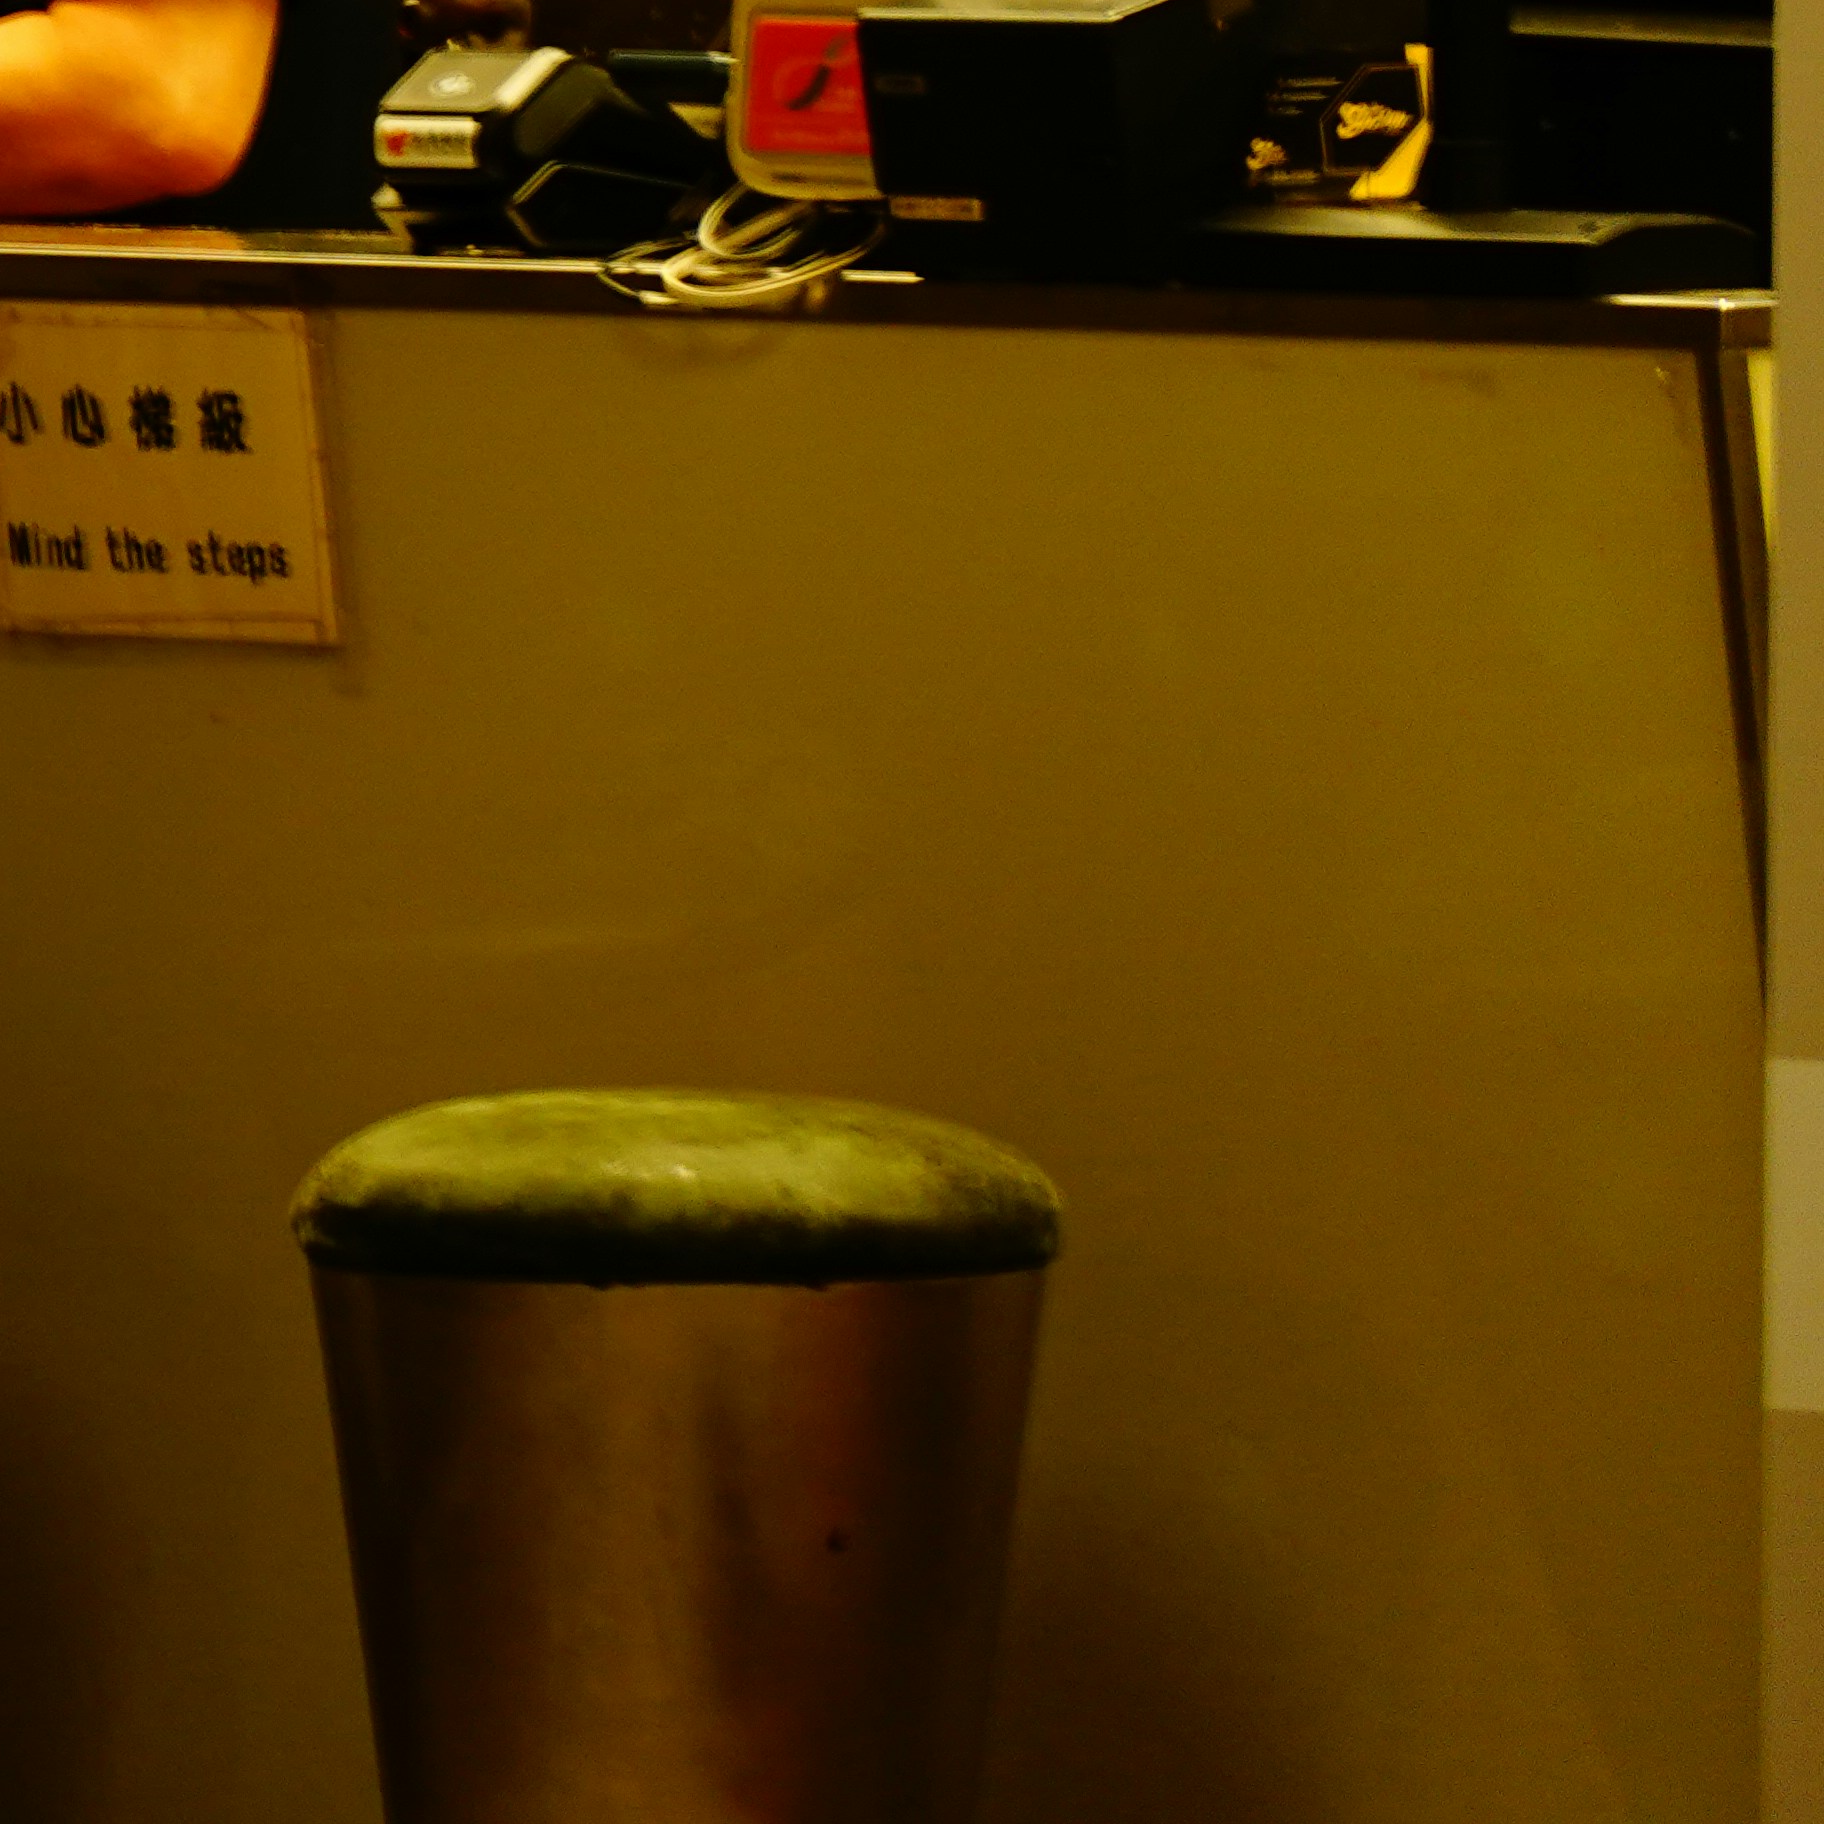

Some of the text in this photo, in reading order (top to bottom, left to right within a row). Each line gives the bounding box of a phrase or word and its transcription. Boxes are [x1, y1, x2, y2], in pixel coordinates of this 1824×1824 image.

[9, 522, 291, 584] Mind the steps
